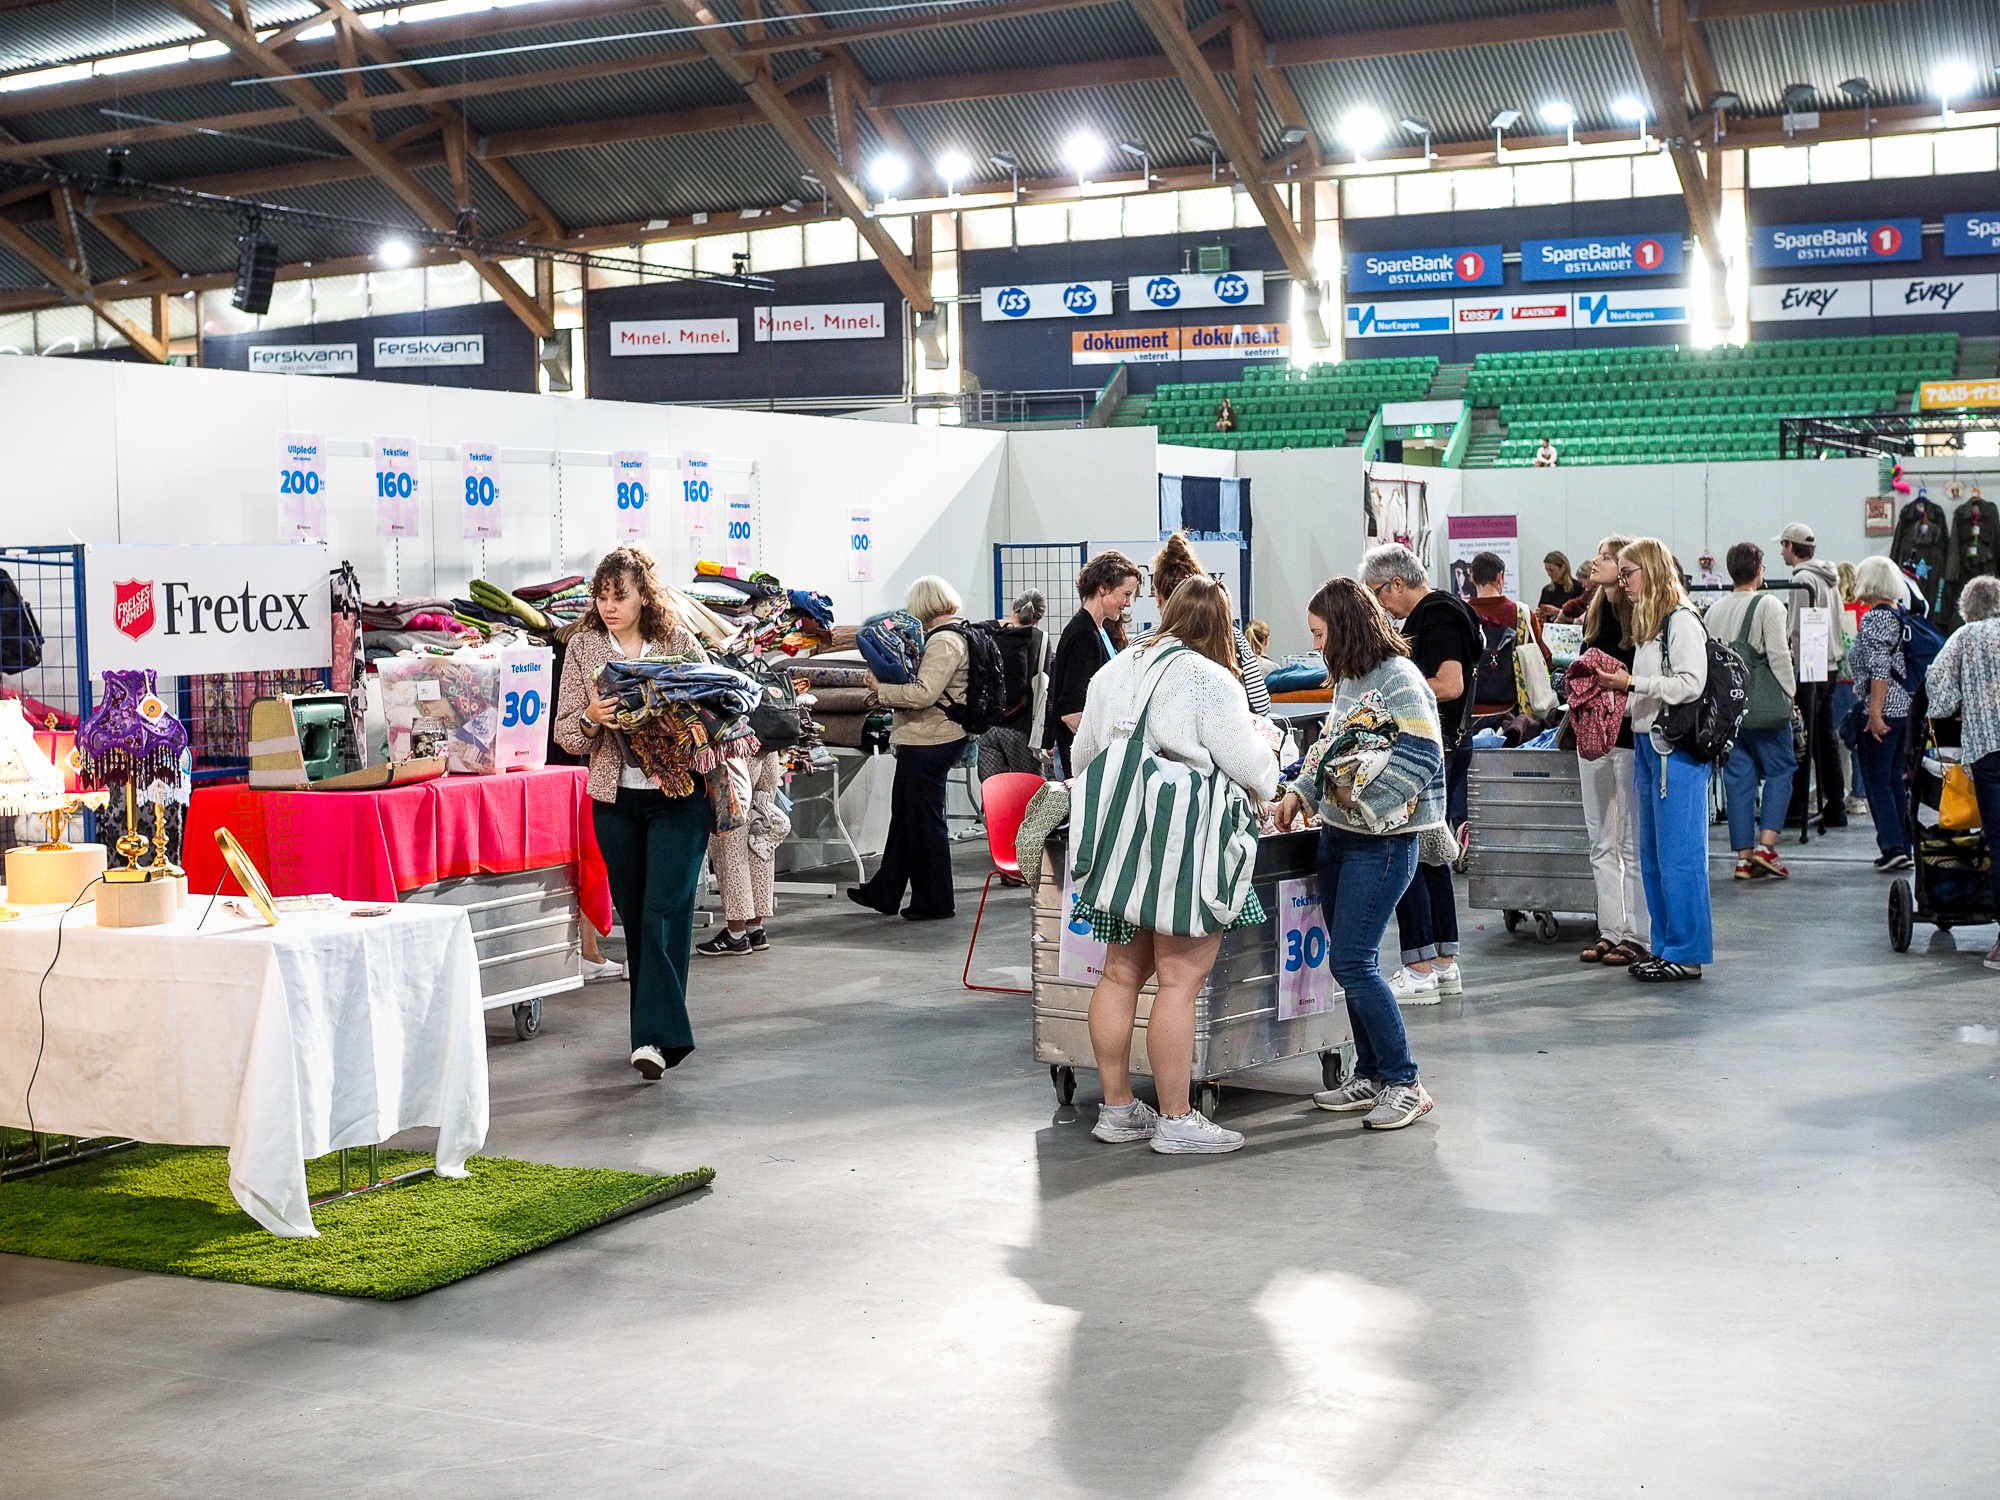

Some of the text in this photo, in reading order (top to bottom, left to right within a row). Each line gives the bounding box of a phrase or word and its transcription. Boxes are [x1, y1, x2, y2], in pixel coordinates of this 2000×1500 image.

[1773, 228, 1892, 250] SpareBank 1
[1541, 242, 1654, 264] SpareBank 1
[1798, 246, 1868, 260] ØSTLANDET
[1366, 254, 1474, 276] SpareBank 1
[1565, 260, 1633, 274] ØSTLANDET
[1388, 272, 1454, 284] ØSTLANDET
[824, 314, 880, 330] Minel.
[1462, 310, 1491, 320] tesa
[1378, 321, 1420, 331] NorEngros
[621, 330, 730, 345] Minel. Minel.
[1083, 331, 1168, 350] dokument
[1192, 327, 1280, 346] dokument
[1244, 348, 1279, 356] senteret
[288, 445, 316, 455] Ullpledd
[383, 448, 409, 457] Tekstiler
[469, 453, 492, 462] Tekstiler
[620, 460, 642, 468] Tekstiler
[280, 470, 319, 494] 200
[376, 472, 412, 498] 160
[466, 476, 494, 506] 80
[617, 482, 644, 510] 80
[683, 480, 710, 502] 160
[728, 522, 750, 540] 200
[850, 534, 868, 550] 100
[162, 580, 310, 636] Fretex
[511, 662, 542, 674] Tekstiler
[502, 690, 547, 728] 30 kr
[1292, 896, 1320, 908] Tekstile
[1285, 926, 1326, 972] 30
